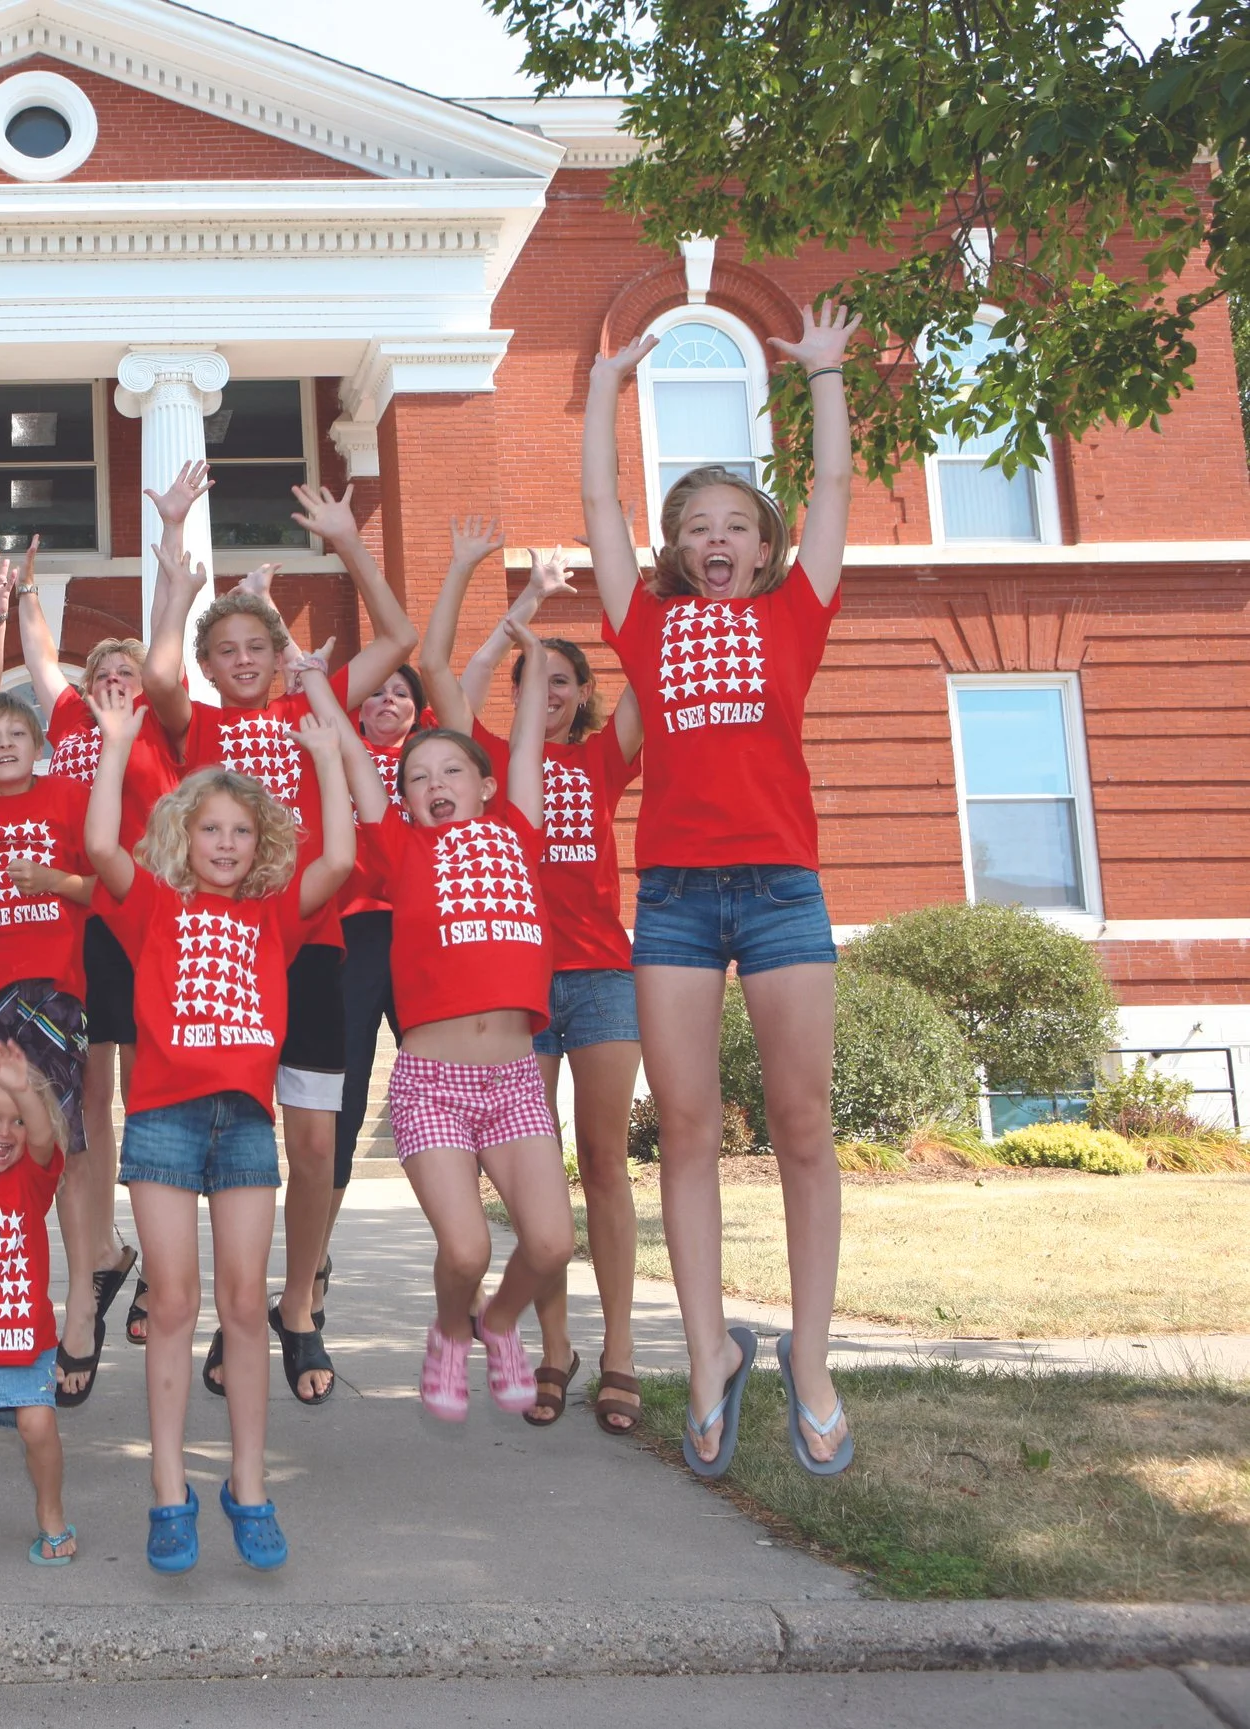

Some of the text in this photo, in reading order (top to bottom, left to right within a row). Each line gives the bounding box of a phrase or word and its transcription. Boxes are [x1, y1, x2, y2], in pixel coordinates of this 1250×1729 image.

[664, 702, 765, 733] I SEE STARS
[549, 844, 597, 862] STARS
[13, 901, 59, 923] STARS
[439, 919, 542, 947] I SEE STARS
[171, 1023, 275, 1047] I SEE STARS
